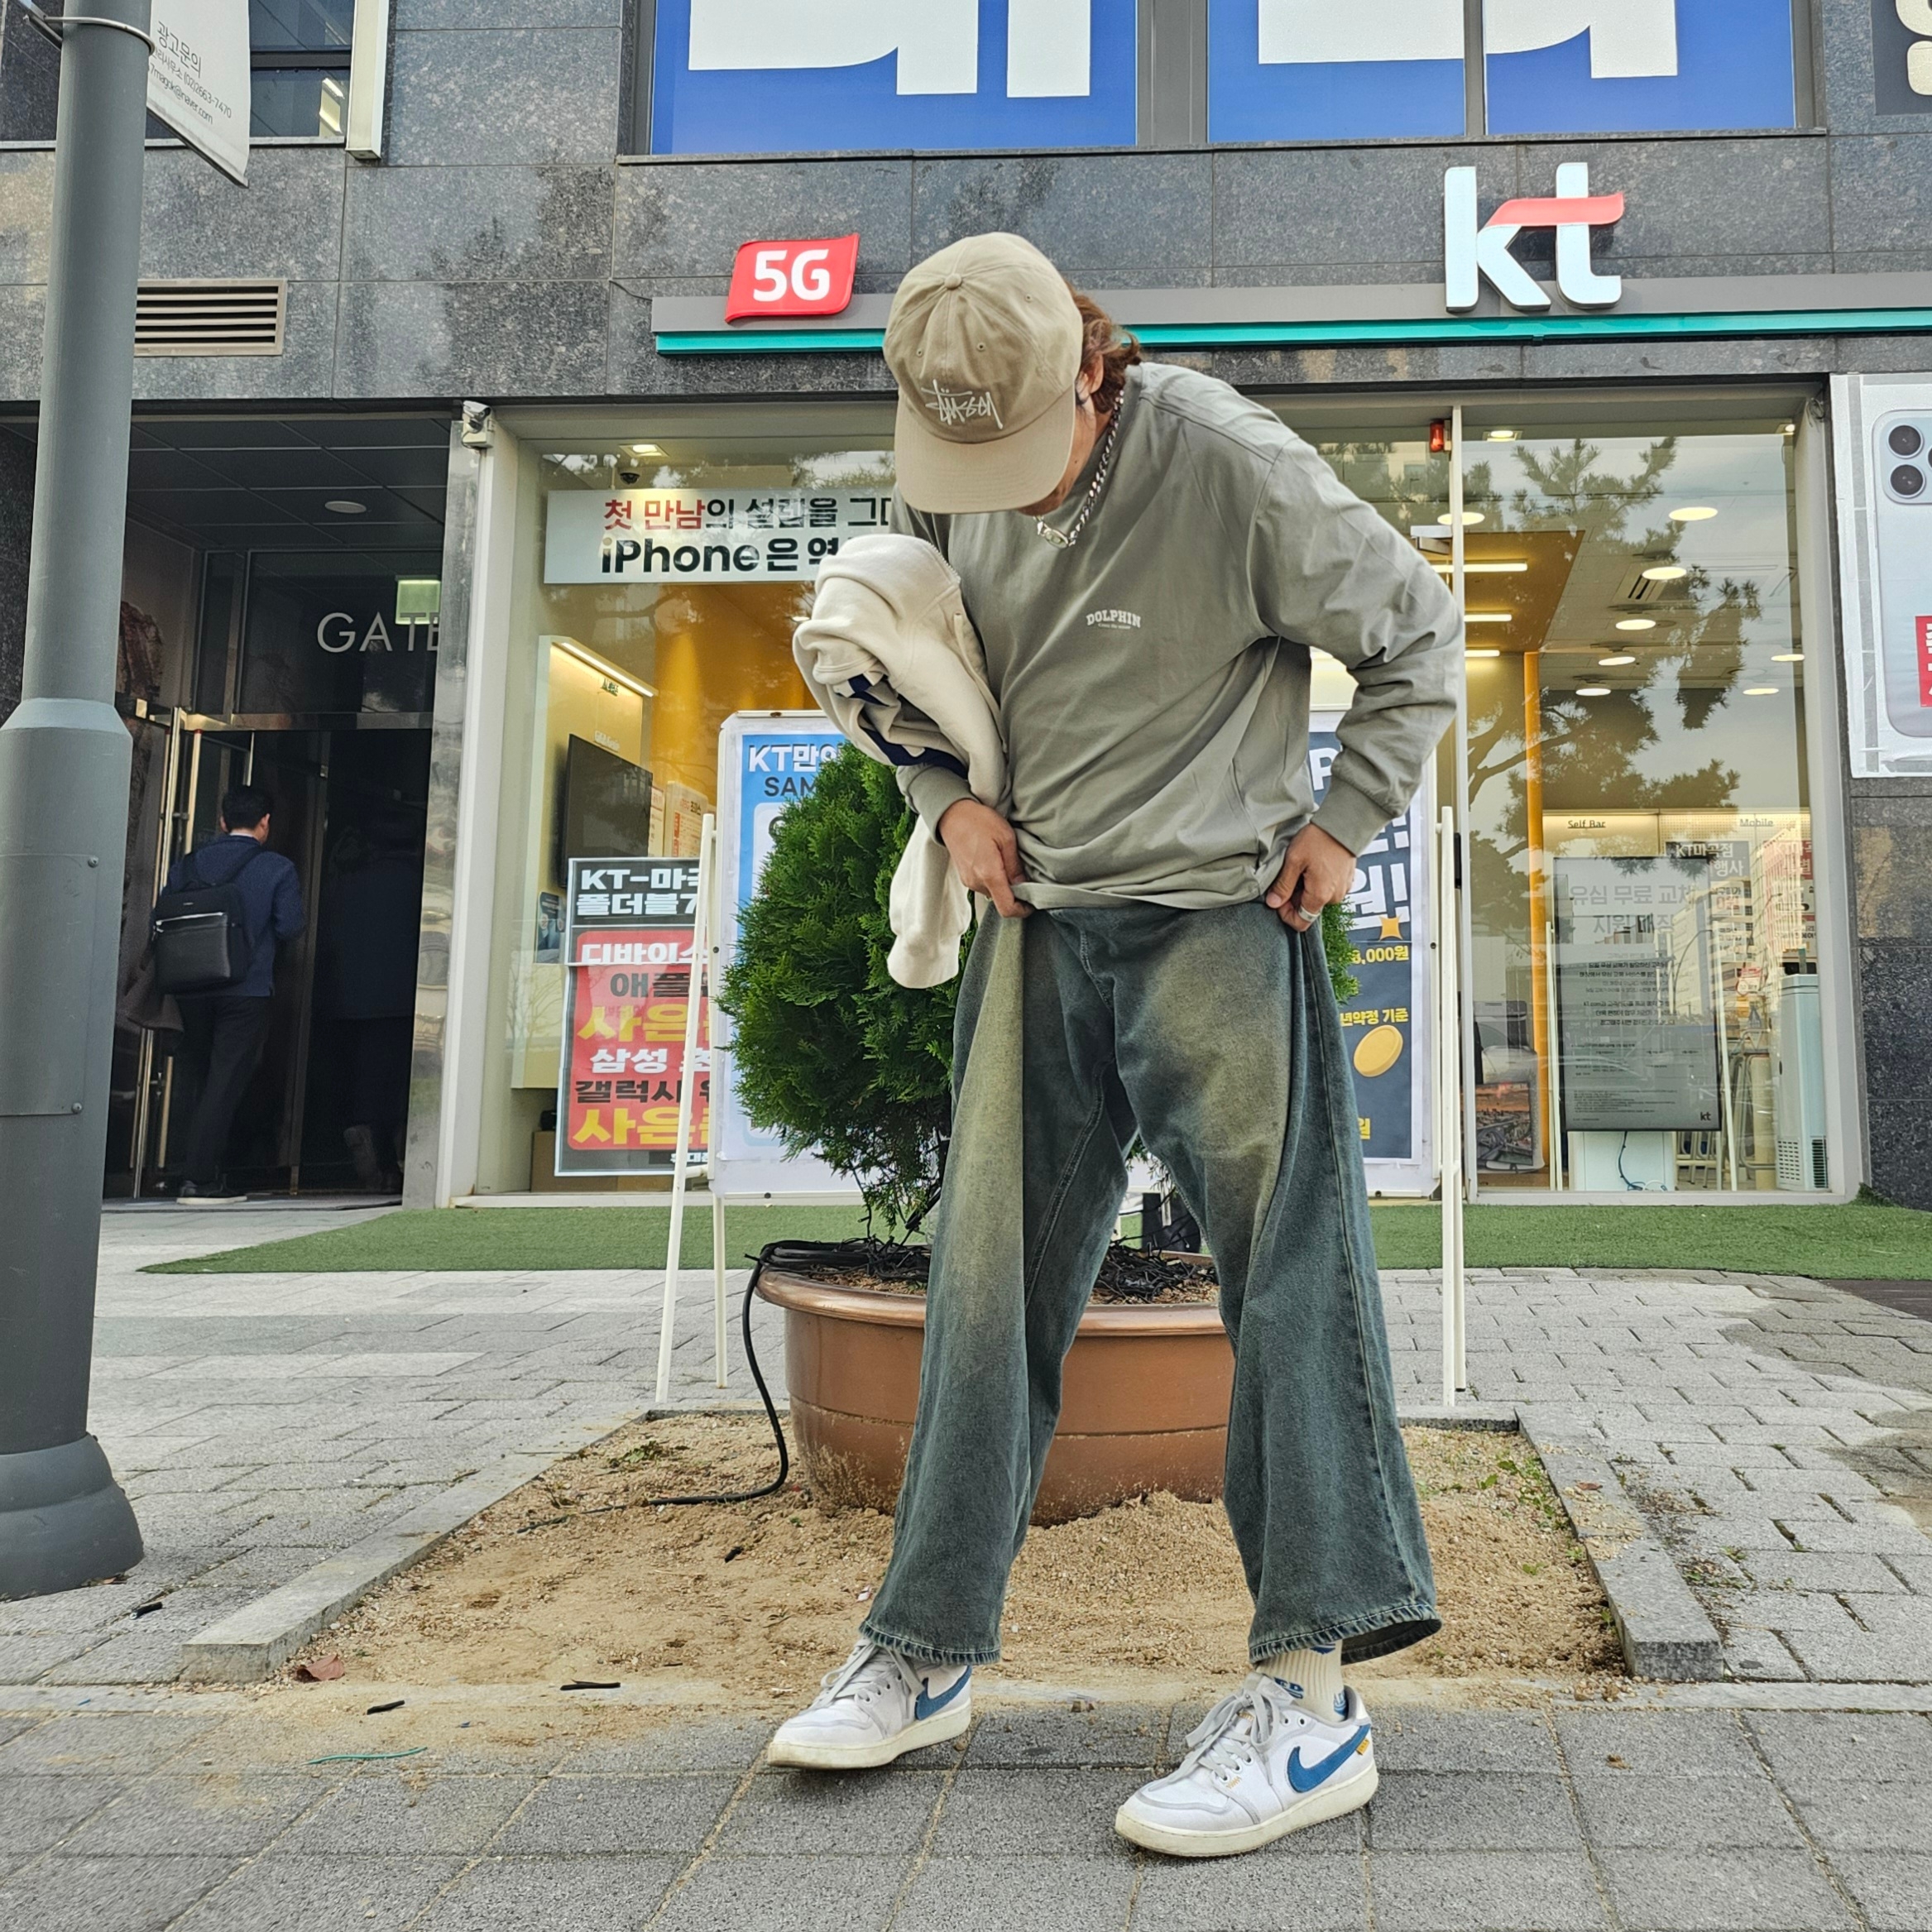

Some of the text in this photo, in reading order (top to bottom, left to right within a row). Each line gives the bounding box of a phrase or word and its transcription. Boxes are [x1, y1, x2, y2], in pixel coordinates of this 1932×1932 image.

[157, 21, 201, 79] 광고문의
[149, 63, 213, 124] 7magok@naver.com
[184, 71, 233, 118] (02)2663-7470
[752, 248, 831, 303] 5G
[604, 499, 632, 530] 첫
[644, 497, 735, 530] 만남의
[847, 497, 893, 527] 그
[1086, 609, 1141, 628] DOLPHIN
[1568, 819, 1607, 829] Self Bar
[1739, 817, 1774, 827] Mobile
[1570, 885, 1608, 906] 유심
[1614, 885, 1653, 906] 무료
[1594, 913, 1631, 934] 지원
[578, 1004, 709, 1043] 사은
[1382, 1008, 1409, 1024] 기준
[590, 1048, 668, 1073] 삼성
[575, 1080, 682, 1104] 갤럭시
[573, 1106, 709, 1145] 사은
[1699, 1111, 1712, 1121] kt
